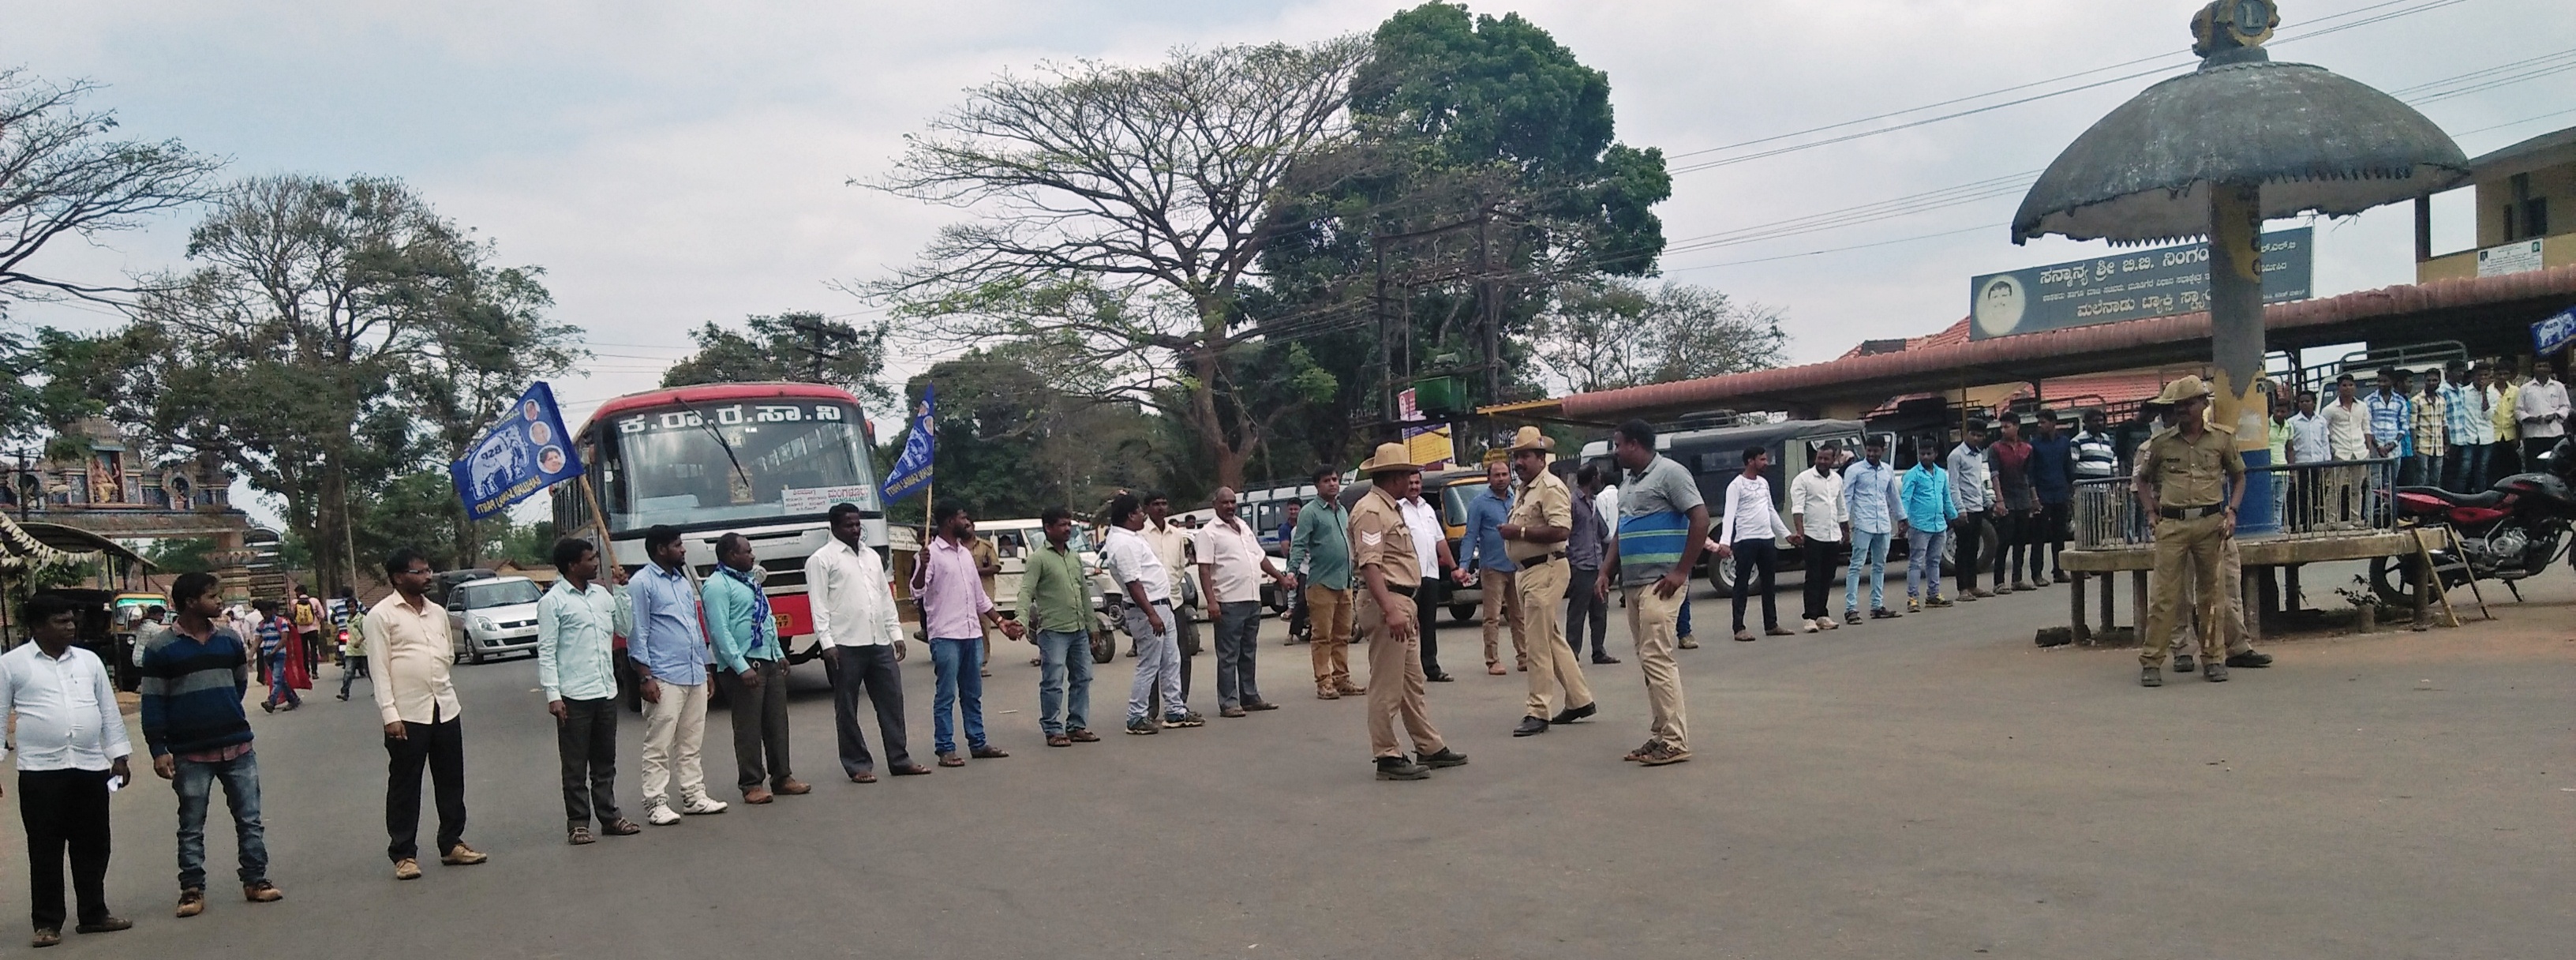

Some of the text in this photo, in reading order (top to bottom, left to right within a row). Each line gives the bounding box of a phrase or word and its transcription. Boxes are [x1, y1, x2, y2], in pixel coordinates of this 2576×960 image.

[2039, 262, 2089, 287] ಸನ್ಮಾನ್ಯ
[2095, 259, 2115, 282] ಶ್ರೀ
[2121, 257, 2155, 272] ಬಿ.ಬಿ.
[2076, 297, 2136, 317] ಮಲೆನಾಡು
